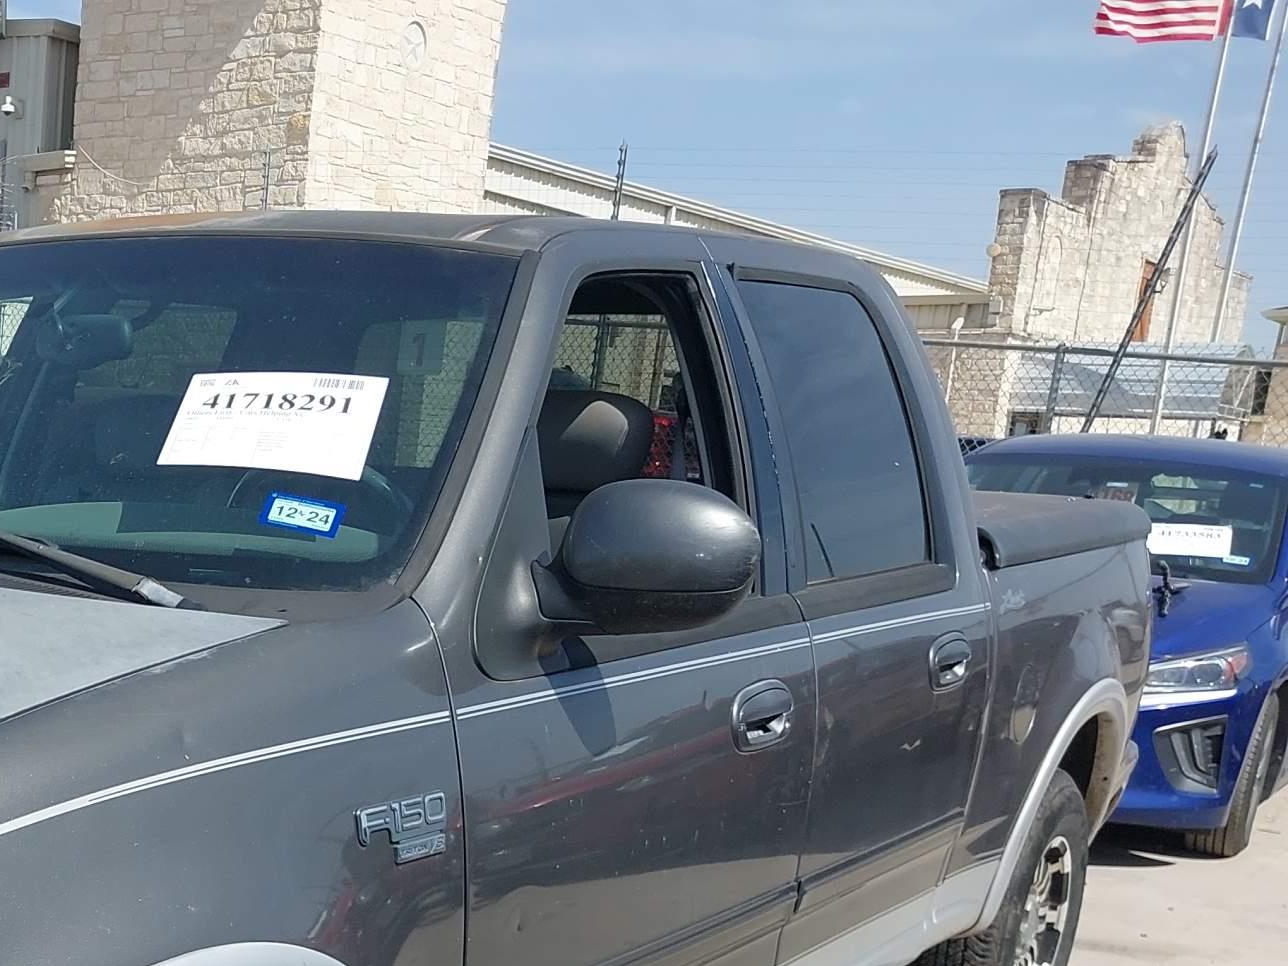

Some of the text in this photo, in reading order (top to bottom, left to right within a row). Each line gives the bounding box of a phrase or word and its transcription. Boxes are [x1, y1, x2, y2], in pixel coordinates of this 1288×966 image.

[202, 392, 354, 414] 41718291
[276, 505, 331, 526] 12 24
